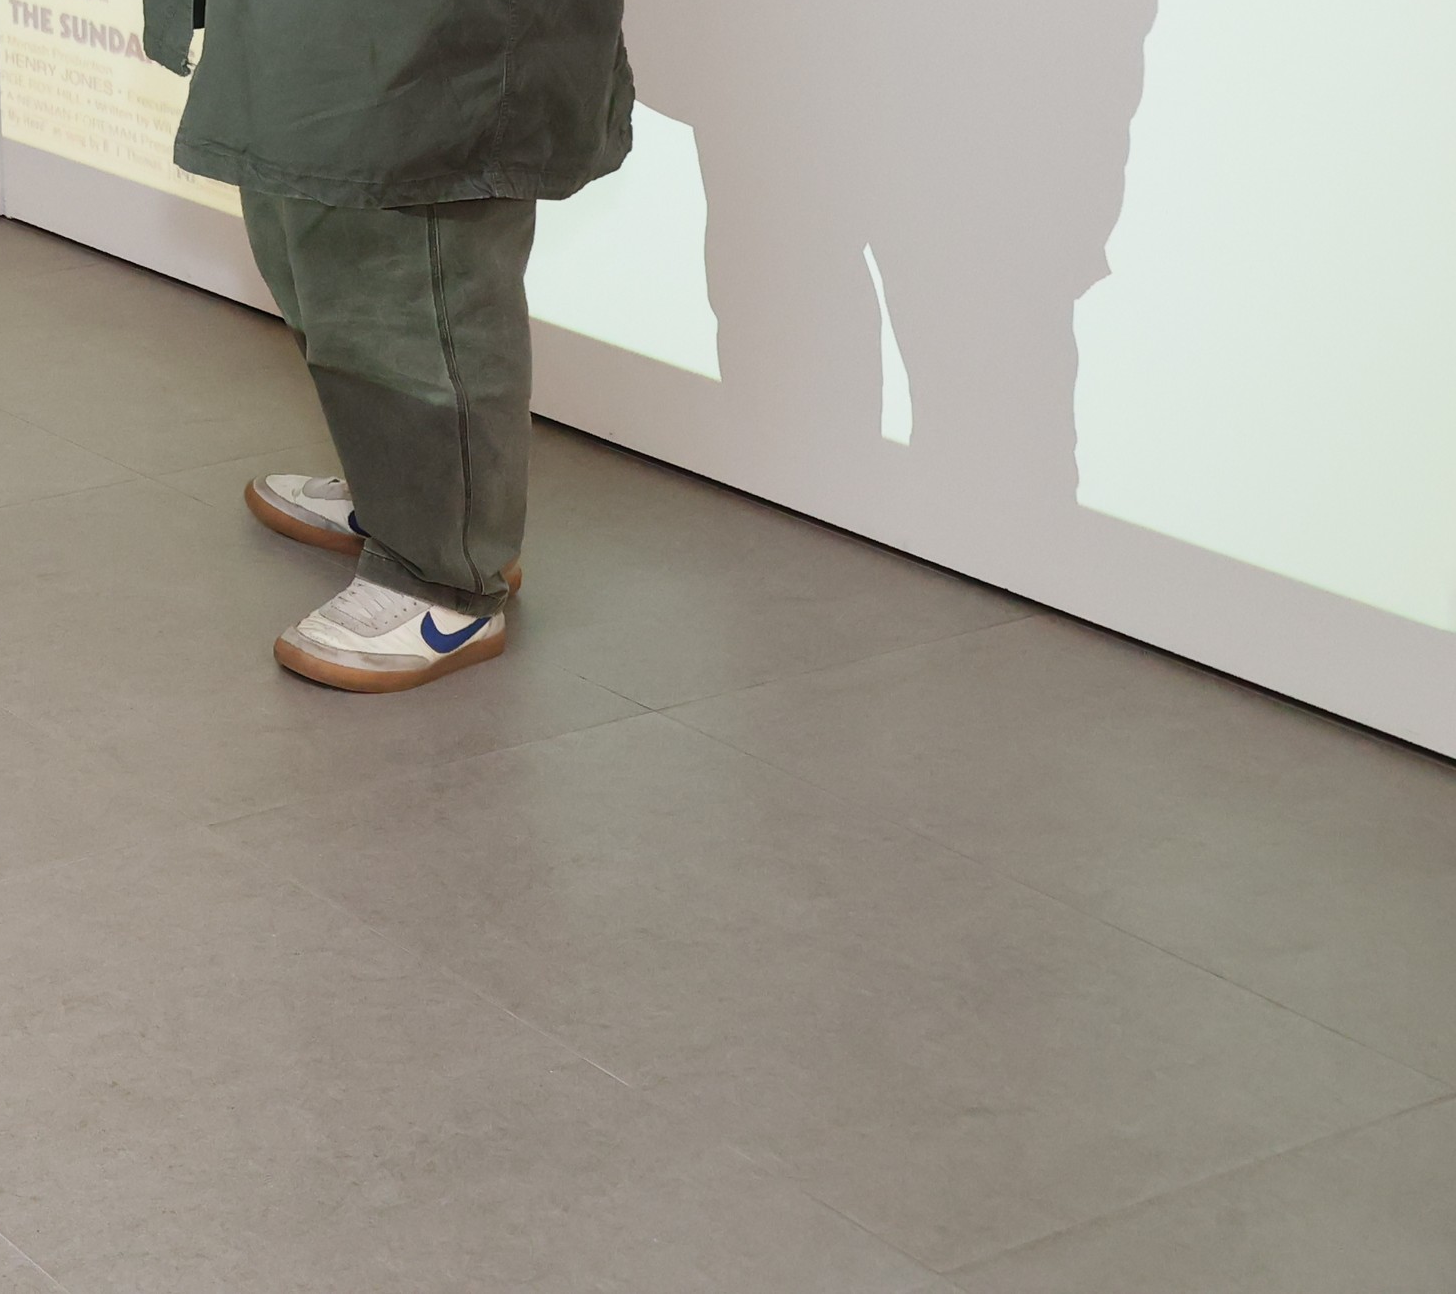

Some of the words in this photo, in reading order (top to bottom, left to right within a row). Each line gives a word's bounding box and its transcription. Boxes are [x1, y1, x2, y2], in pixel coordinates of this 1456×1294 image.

[59, 12, 152, 63] SUNDA
[4, 48, 56, 77] HENRY
[60, 67, 114, 97] JONES
